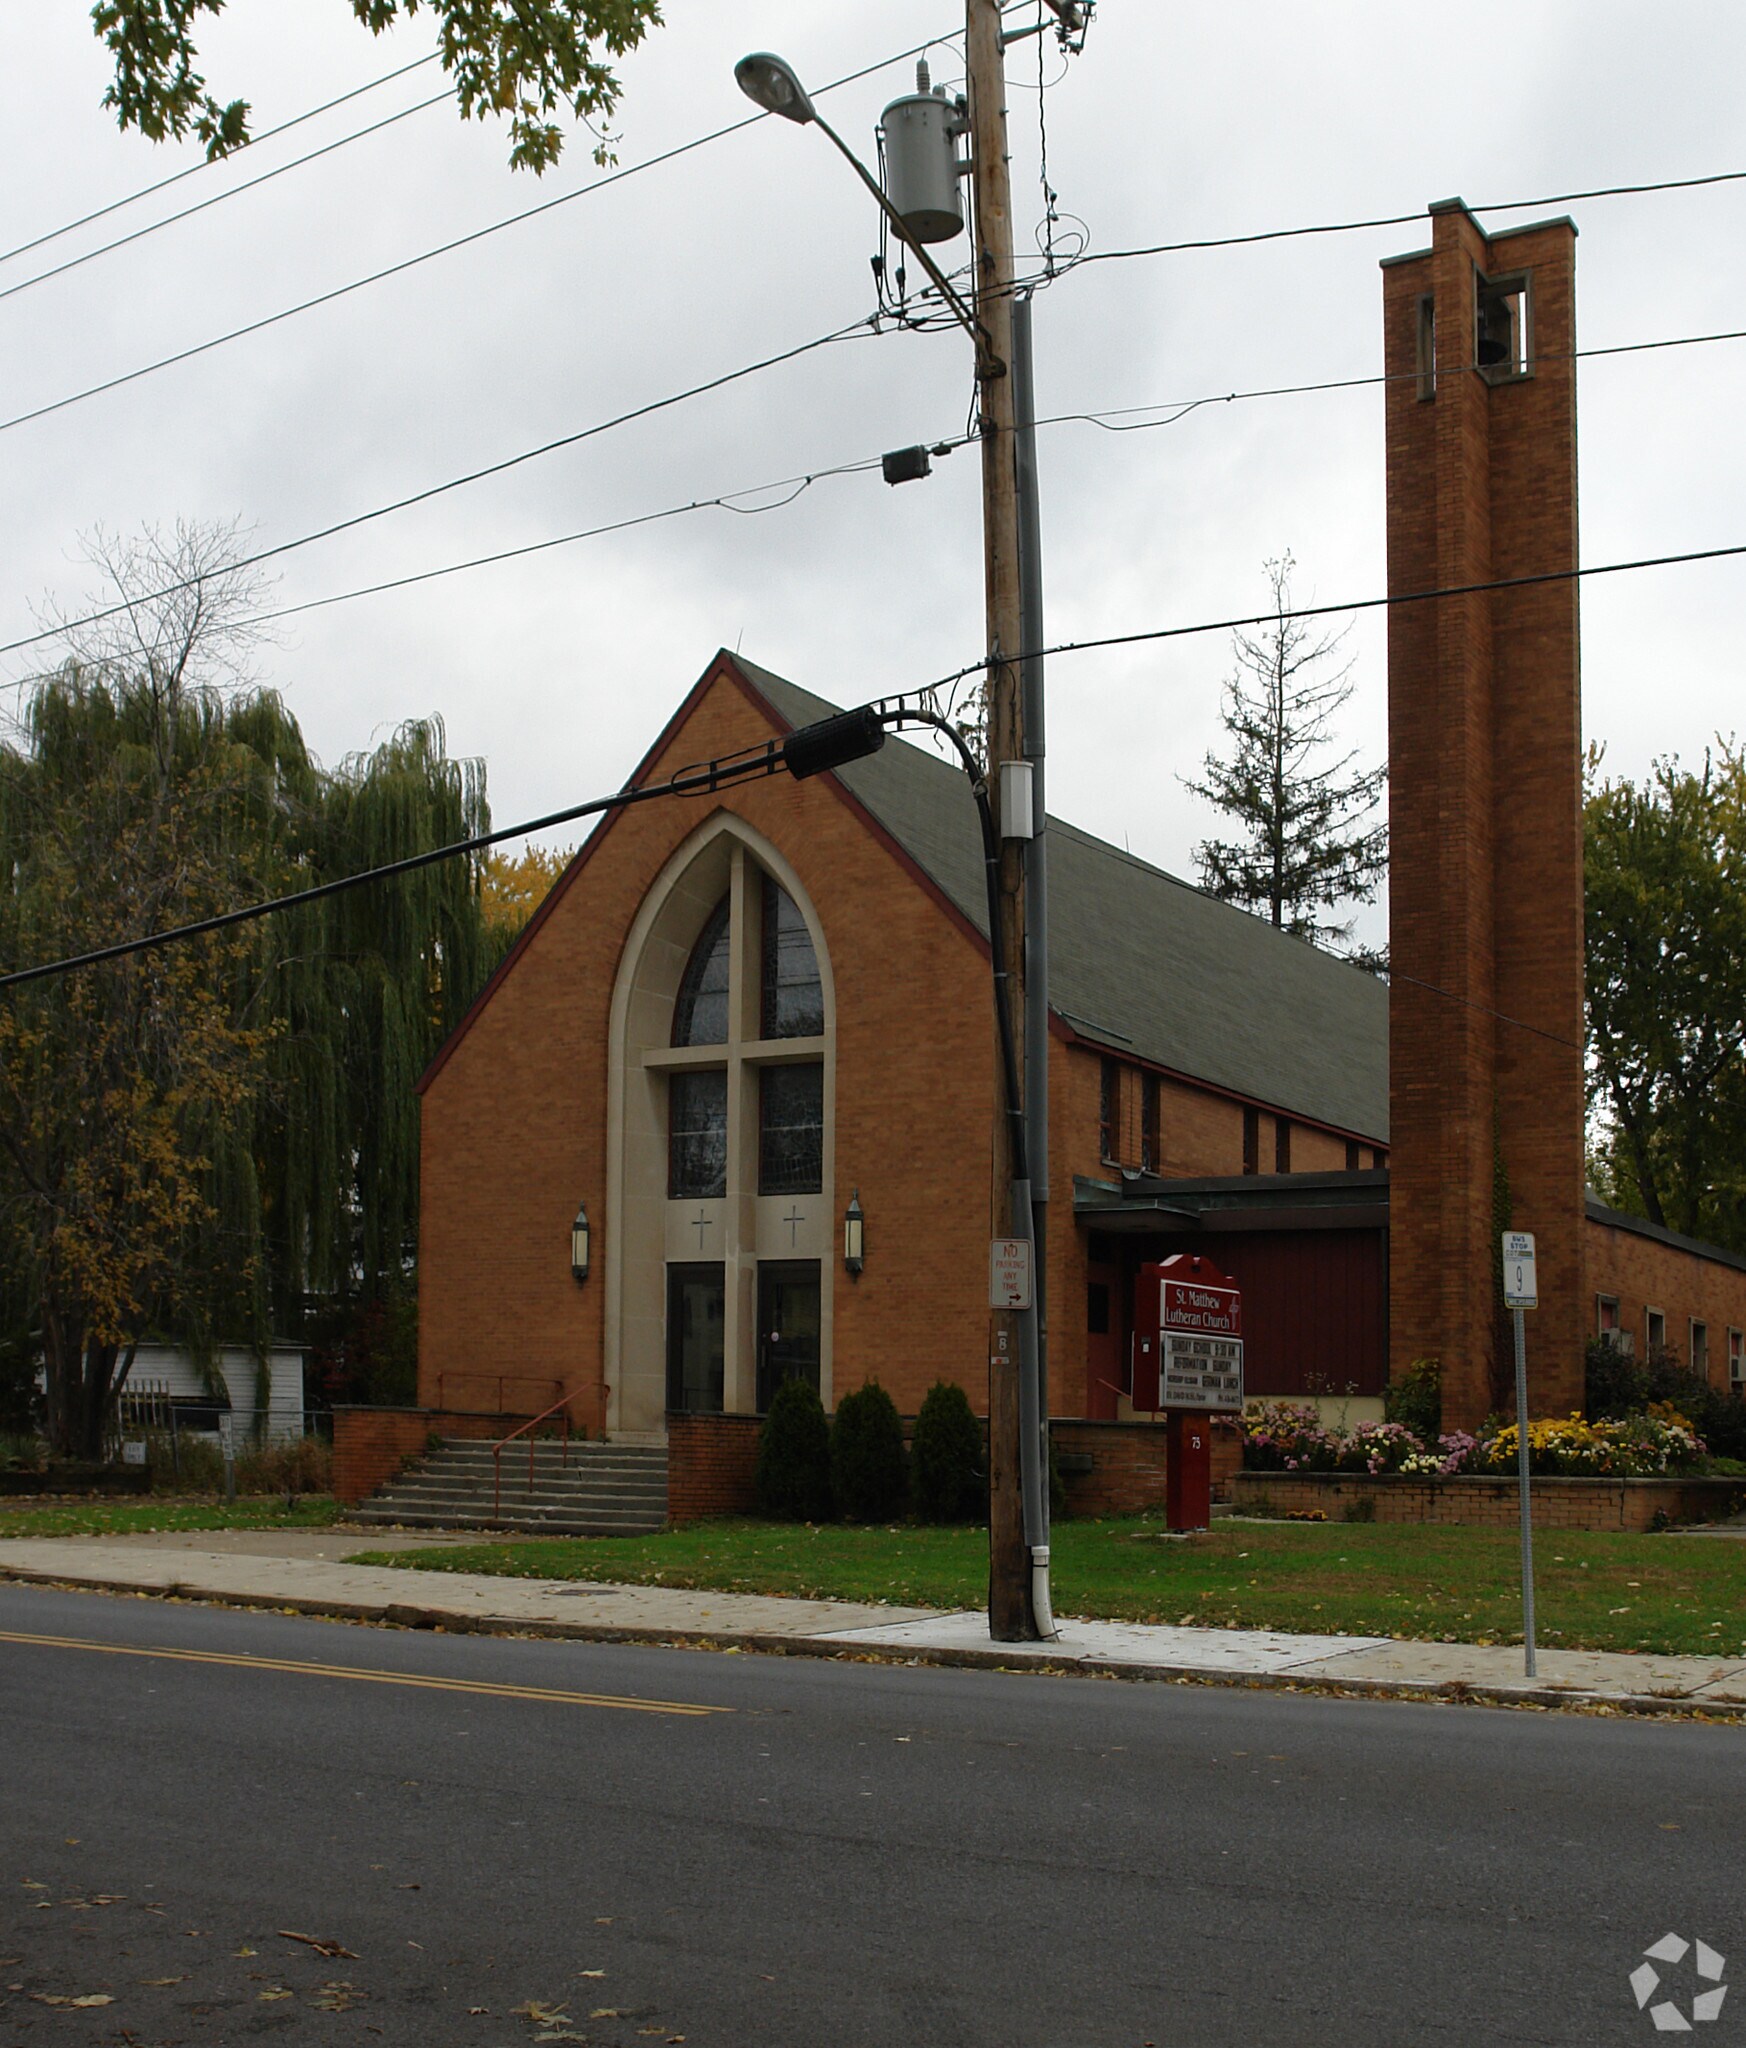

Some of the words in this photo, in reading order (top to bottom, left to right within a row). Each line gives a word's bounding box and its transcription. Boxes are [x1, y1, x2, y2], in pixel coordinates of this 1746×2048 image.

[1003, 1245, 1018, 1258] NO
[996, 1260, 1025, 1270] PARKING
[1003, 1271, 1017, 1280] ANY
[1516, 1266, 1522, 1291] 9
[1002, 1282, 1019, 1292] TIME
[1176, 1288, 1187, 1305] St.
[1189, 1290, 1220, 1310] Matthew
[1166, 1307, 1201, 1326] Lutheran
[1202, 1311, 1230, 1330] Church
[999, 1338, 1007, 1350] 8
[1192, 1436, 1201, 1450] 75
